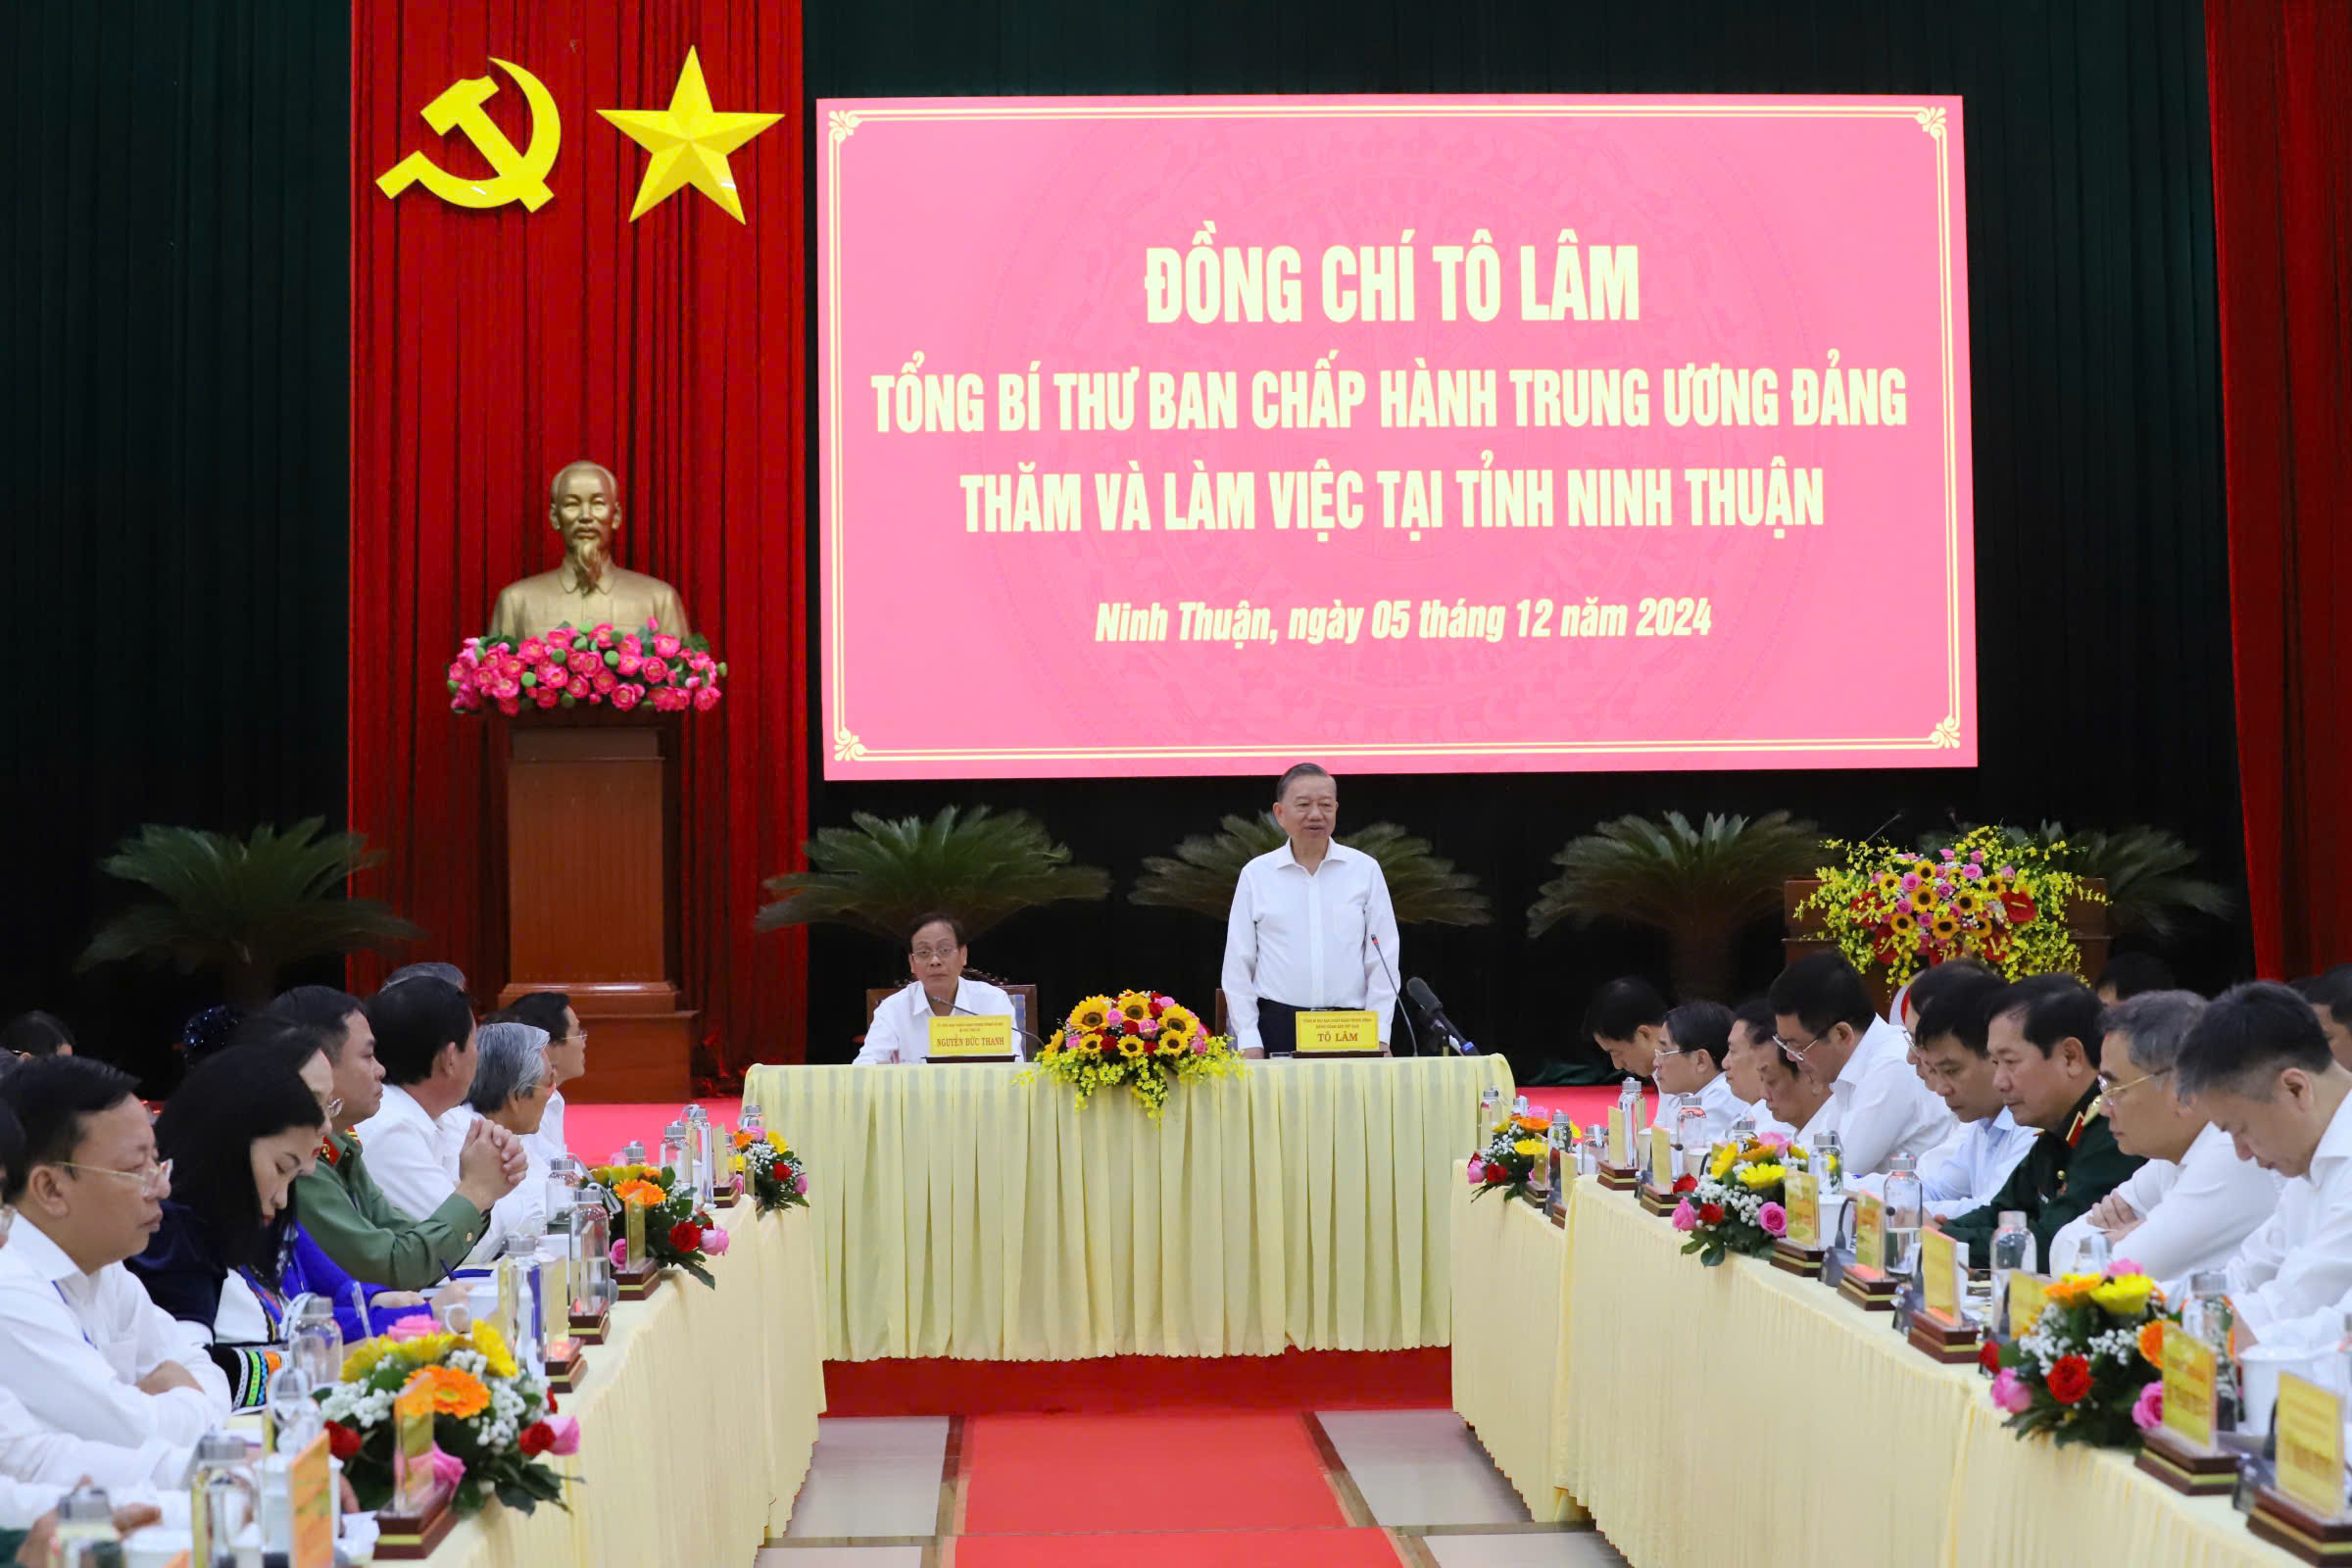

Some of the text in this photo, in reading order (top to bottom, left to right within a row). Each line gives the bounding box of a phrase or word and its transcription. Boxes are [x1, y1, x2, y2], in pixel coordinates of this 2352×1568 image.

[1145, 220, 1639, 323] ĐỒNG CHÍ TÔ LÂM
[871, 349, 1906, 433] TỔNG BÍ THƯ BAN CHẤP HÀNH TRUNG ƯƠNG ĐẢNG
[960, 450, 1823, 542] THĂM VÀ LÀM VIỆC TẠI TỈNH NINH THUẬN
[1096, 597, 1711, 649] Ninh Thuận, ngày 05 tháng 12 năm 2024
[982, 1036, 1004, 1046] THANH
[1317, 1030, 1358, 1042] TÔ LÂM
